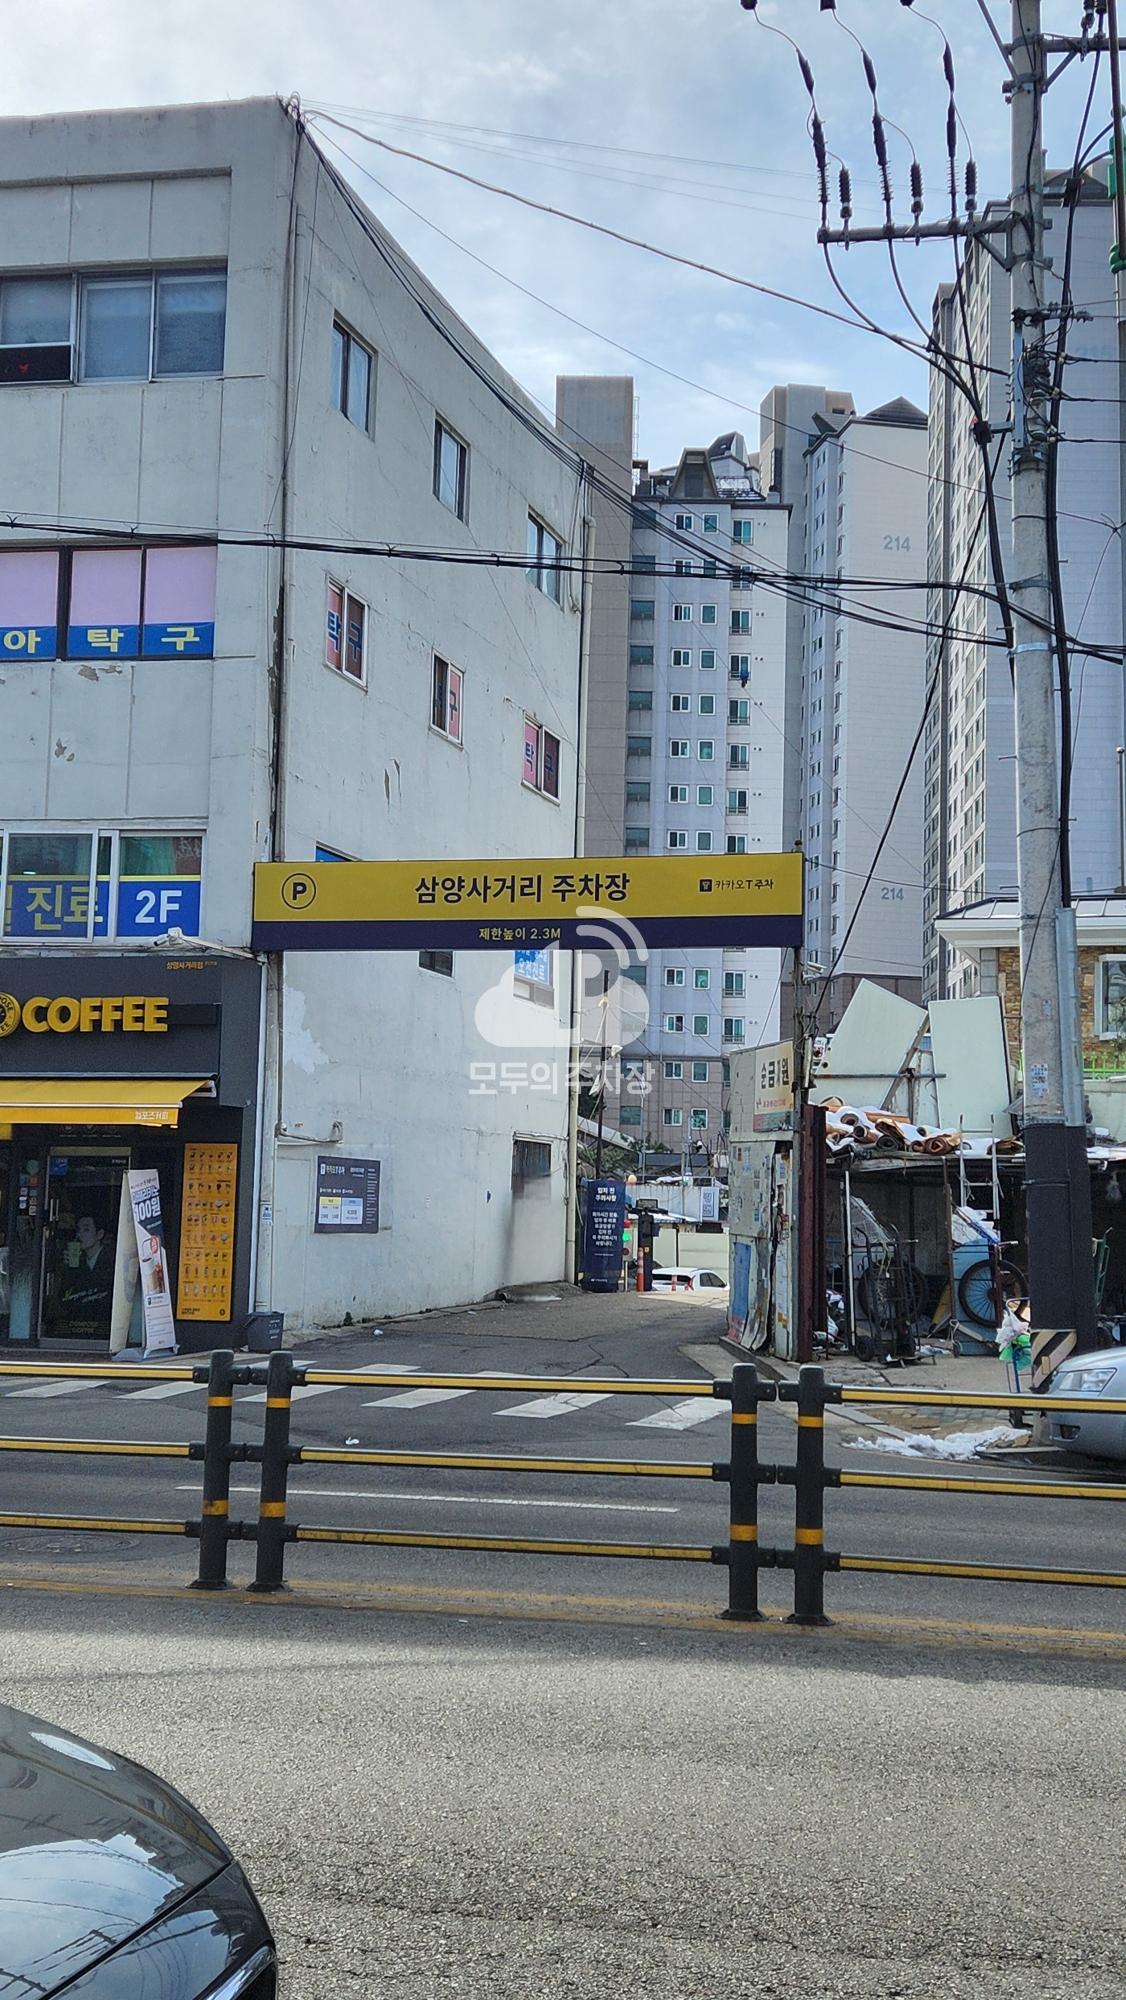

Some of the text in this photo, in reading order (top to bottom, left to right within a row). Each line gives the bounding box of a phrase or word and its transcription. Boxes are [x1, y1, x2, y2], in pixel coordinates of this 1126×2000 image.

[882, 535, 911, 552] 214
[292, 882, 307, 901] P
[415, 873, 630, 904] 삼양사거리 주차장
[881, 887, 904, 900] 214
[26, 884, 104, 931] 진료
[134, 889, 183, 924] 2F
[479, 927, 561, 940] 제한높이 2.3M
[22, 996, 169, 1033] COFFEE
